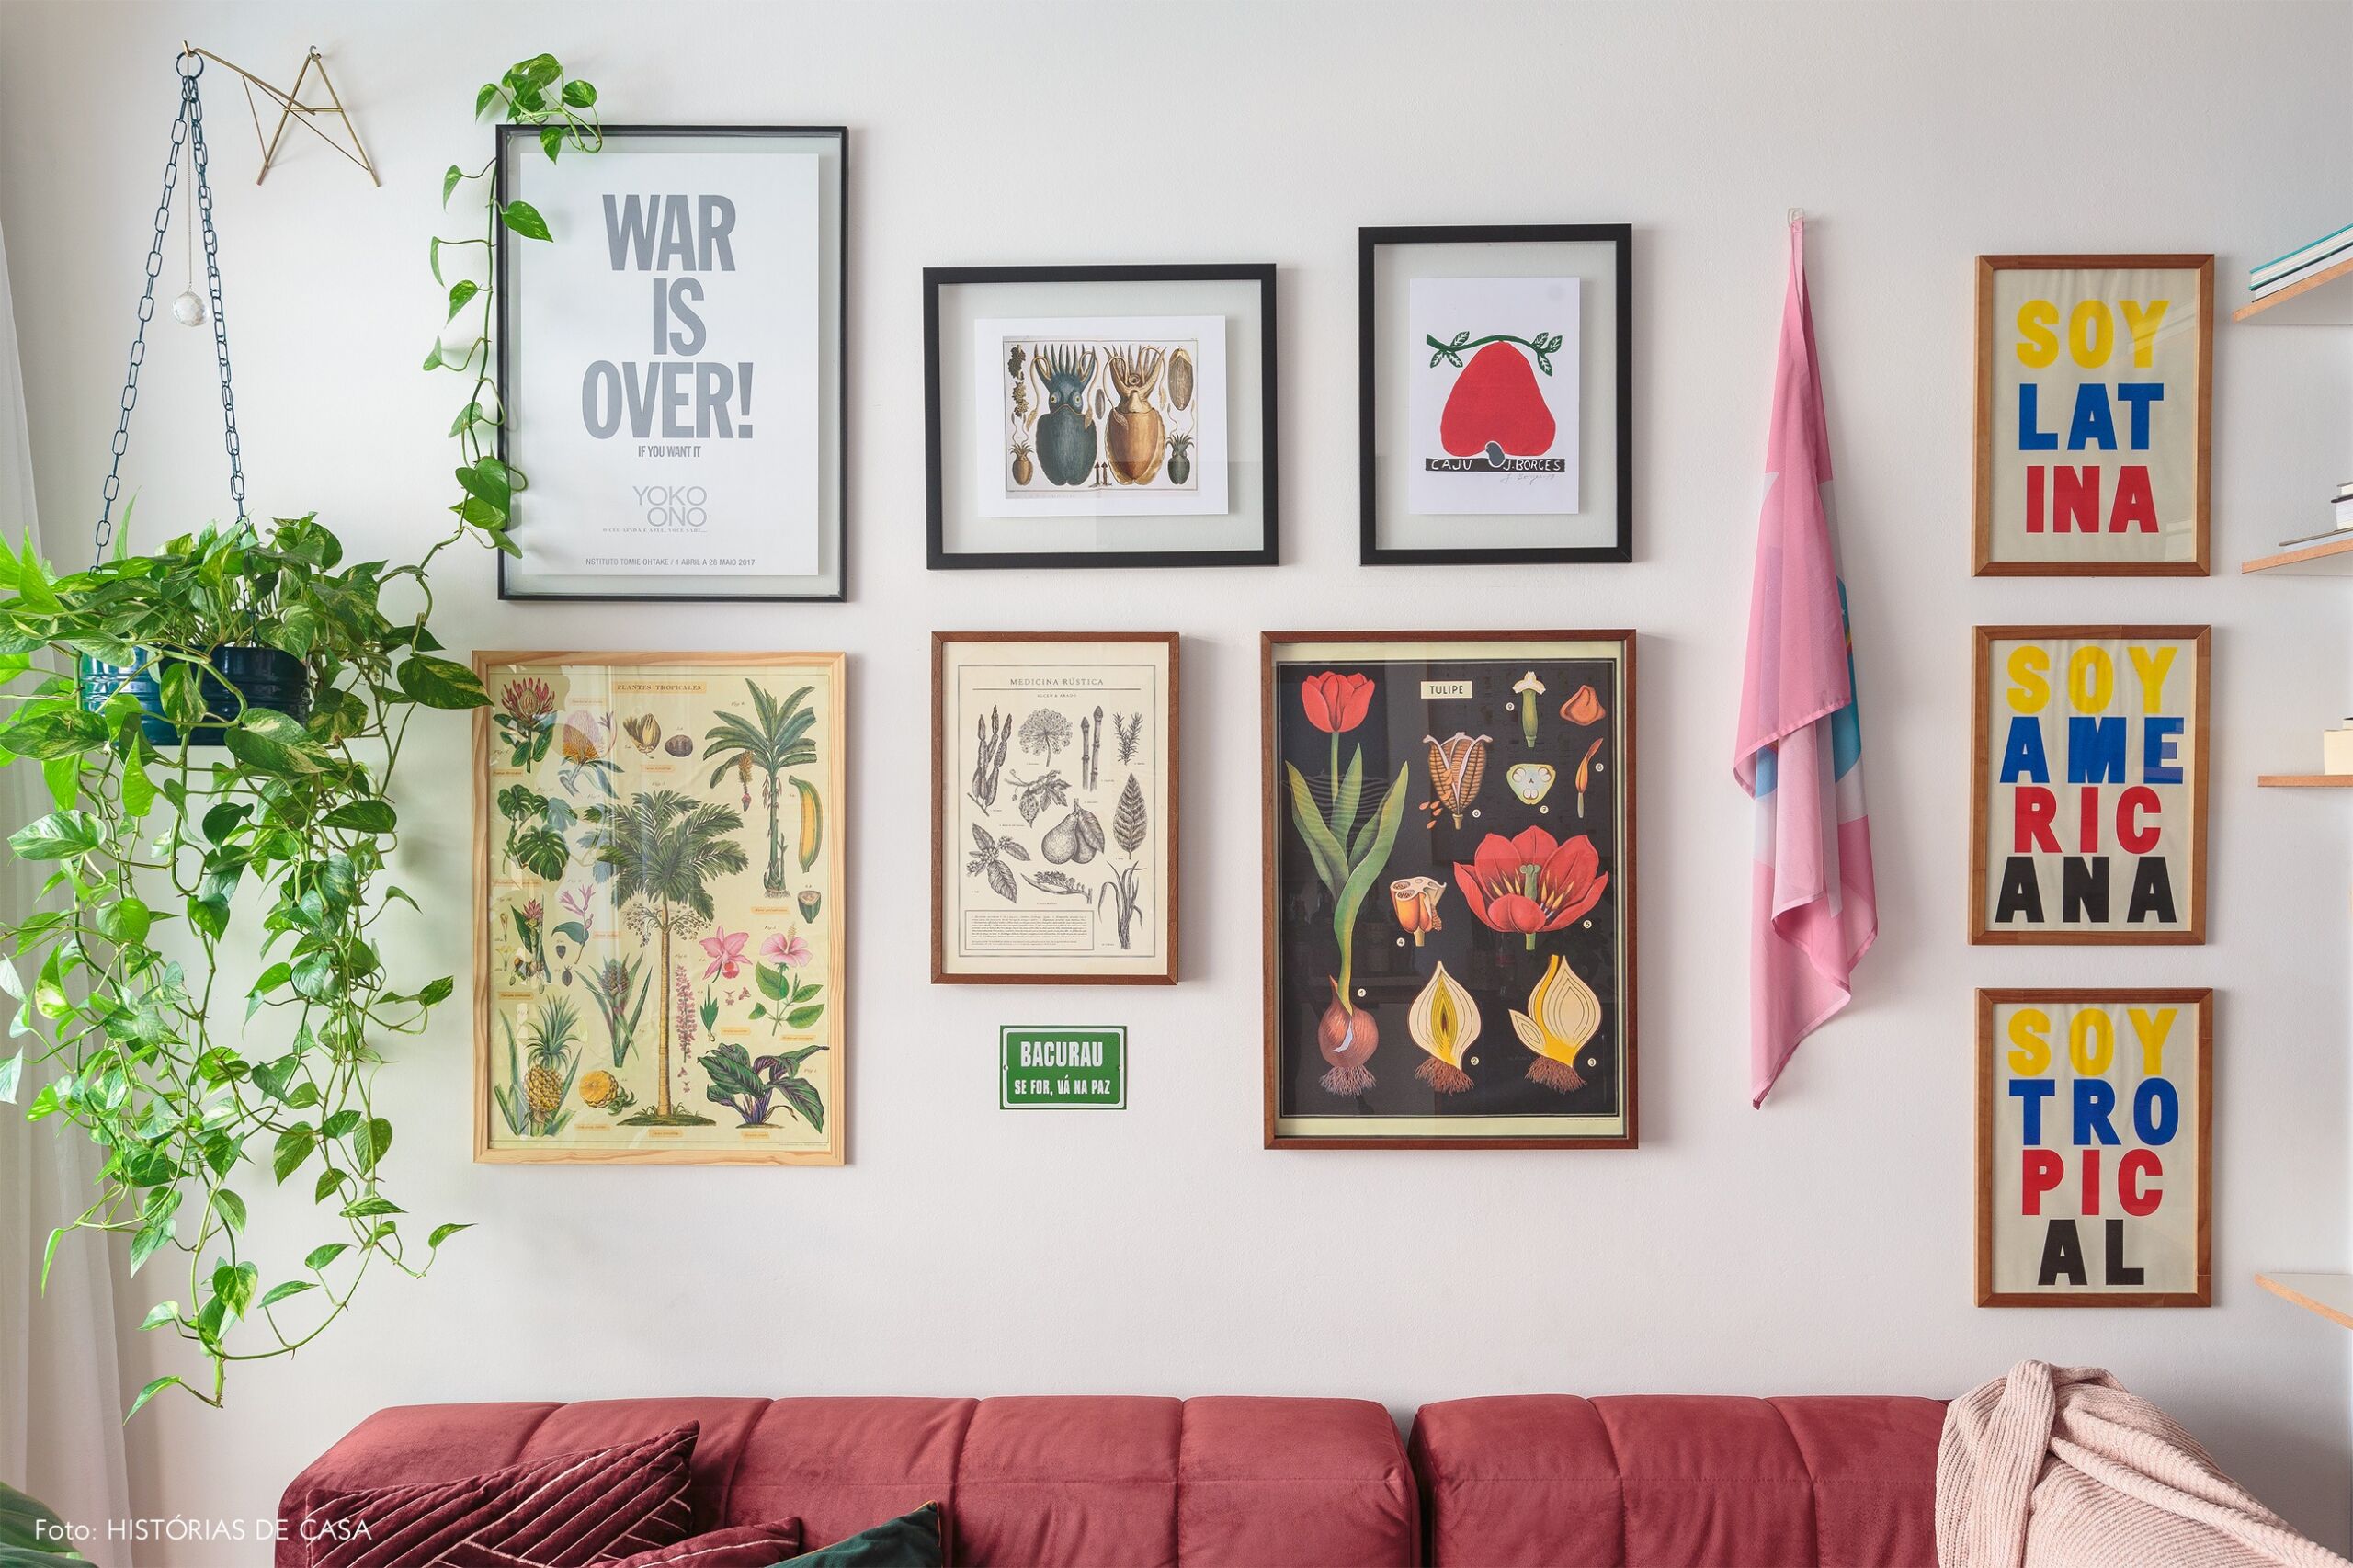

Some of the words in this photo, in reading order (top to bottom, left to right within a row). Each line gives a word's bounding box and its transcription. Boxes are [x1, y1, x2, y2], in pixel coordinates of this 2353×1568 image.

[602, 194, 736, 271] WAR
[654, 278, 707, 357] IS
[2017, 300, 2170, 369] SOY
[582, 360, 754, 439] OVER!
[2018, 383, 2165, 450] LAT
[638, 445, 646, 458] IF
[648, 445, 665, 458] YOU
[667, 445, 692, 458] WANT
[693, 445, 702, 458] IT
[1431, 460, 1472, 470] CAJU
[632, 485, 708, 506] YOKO
[646, 506, 708, 528] ONO
[2026, 466, 2159, 533] INA
[584, 558, 619, 566] INSTITUTO
[620, 558, 642, 566] TOMIE
[642, 558, 669, 566] OHTAKE
[681, 558, 701, 566] ABRIL
[701, 558, 708, 566] A
[719, 558, 737, 566] MAIO
[738, 558, 756, 566] 2017
[1063, 676, 1104, 686] RÚSTICA
[1429, 685, 1463, 695] TULIPE
[2006, 645, 2177, 715] SOY
[2000, 717, 2184, 784] AME
[2014, 786, 2162, 854] RIC
[1995, 857, 2177, 923] ANA
[1020, 1041, 1103, 1067] BACURAU
[2007, 1007, 2178, 1077] SOY
[1014, 1079, 1027, 1095] SE
[1030, 1079, 1053, 1097] FOR,
[1057, 1074, 1071, 1095] VÁ
[1074, 1079, 1088, 1095] NA
[1091, 1079, 1111, 1095] PAZ
[2008, 1078, 2178, 1146] TRO
[2022, 1149, 2163, 1216] PIC
[2038, 1219, 2144, 1286] AL
